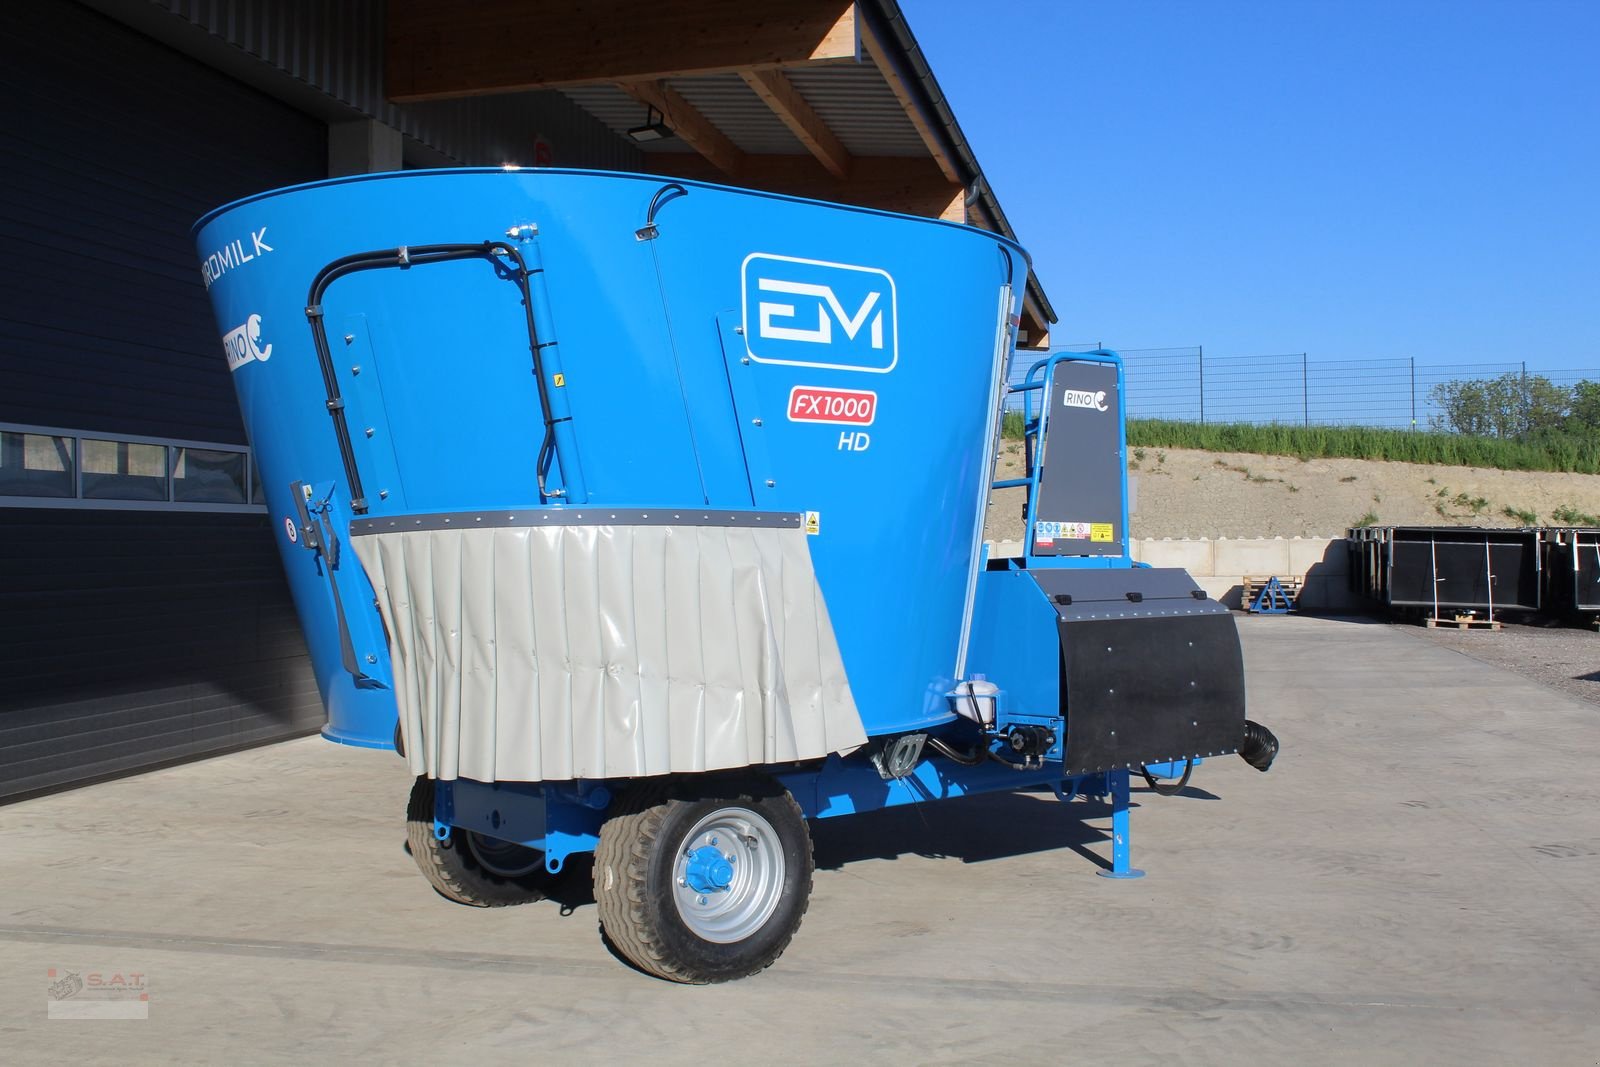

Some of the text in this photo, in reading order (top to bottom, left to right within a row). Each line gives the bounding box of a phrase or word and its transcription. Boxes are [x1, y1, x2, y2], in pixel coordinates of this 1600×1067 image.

[758, 277, 883, 349] EM
[794, 395, 871, 418] FX1000
[1066, 392, 1092, 406] RINO
[837, 432, 870, 451] HD
